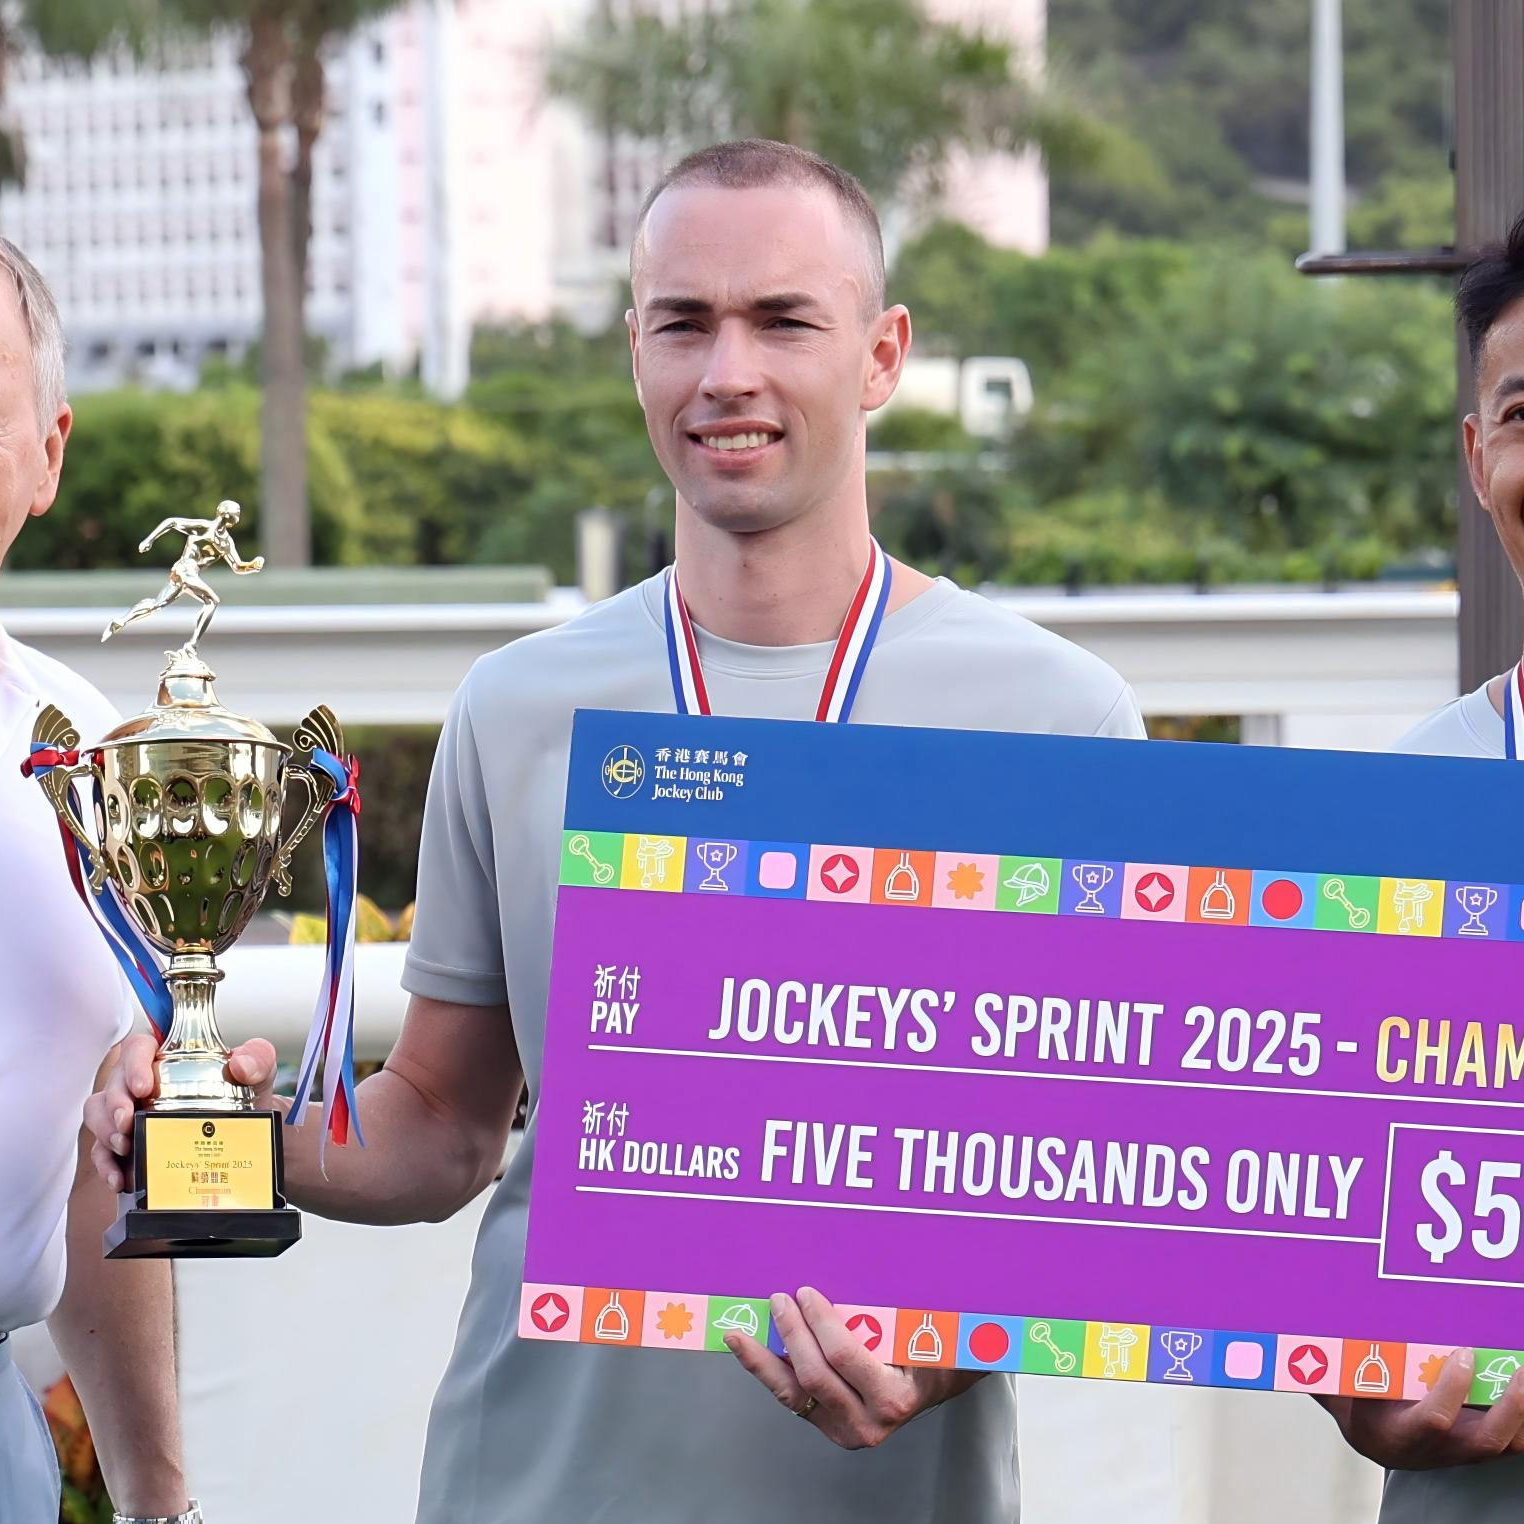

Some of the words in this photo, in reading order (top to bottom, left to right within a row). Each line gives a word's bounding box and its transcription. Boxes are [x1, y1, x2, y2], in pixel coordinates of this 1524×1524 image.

[654, 747, 749, 767] 香港賽馬會
[651, 784, 693, 803] Jockey
[694, 786, 724, 801] Club
[654, 765, 677, 780] The
[679, 766, 711, 785] Hong
[713, 769, 744, 787] Kong
[593, 964, 642, 1001] 祈付
[590, 1000, 641, 1035] PAY
[708, 977, 956, 1053] JOCKEYS'
[970, 992, 1165, 1067] SPRINT
[1180, 1005, 1322, 1077] 2025
[581, 1100, 630, 1137] 祈付
[579, 1138, 616, 1172] HK
[622, 1141, 741, 1180] DOLLARS
[760, 1119, 878, 1189] FIVE
[893, 1127, 1210, 1211] THOUSANDS
[1225, 1148, 1365, 1220] ONLY
